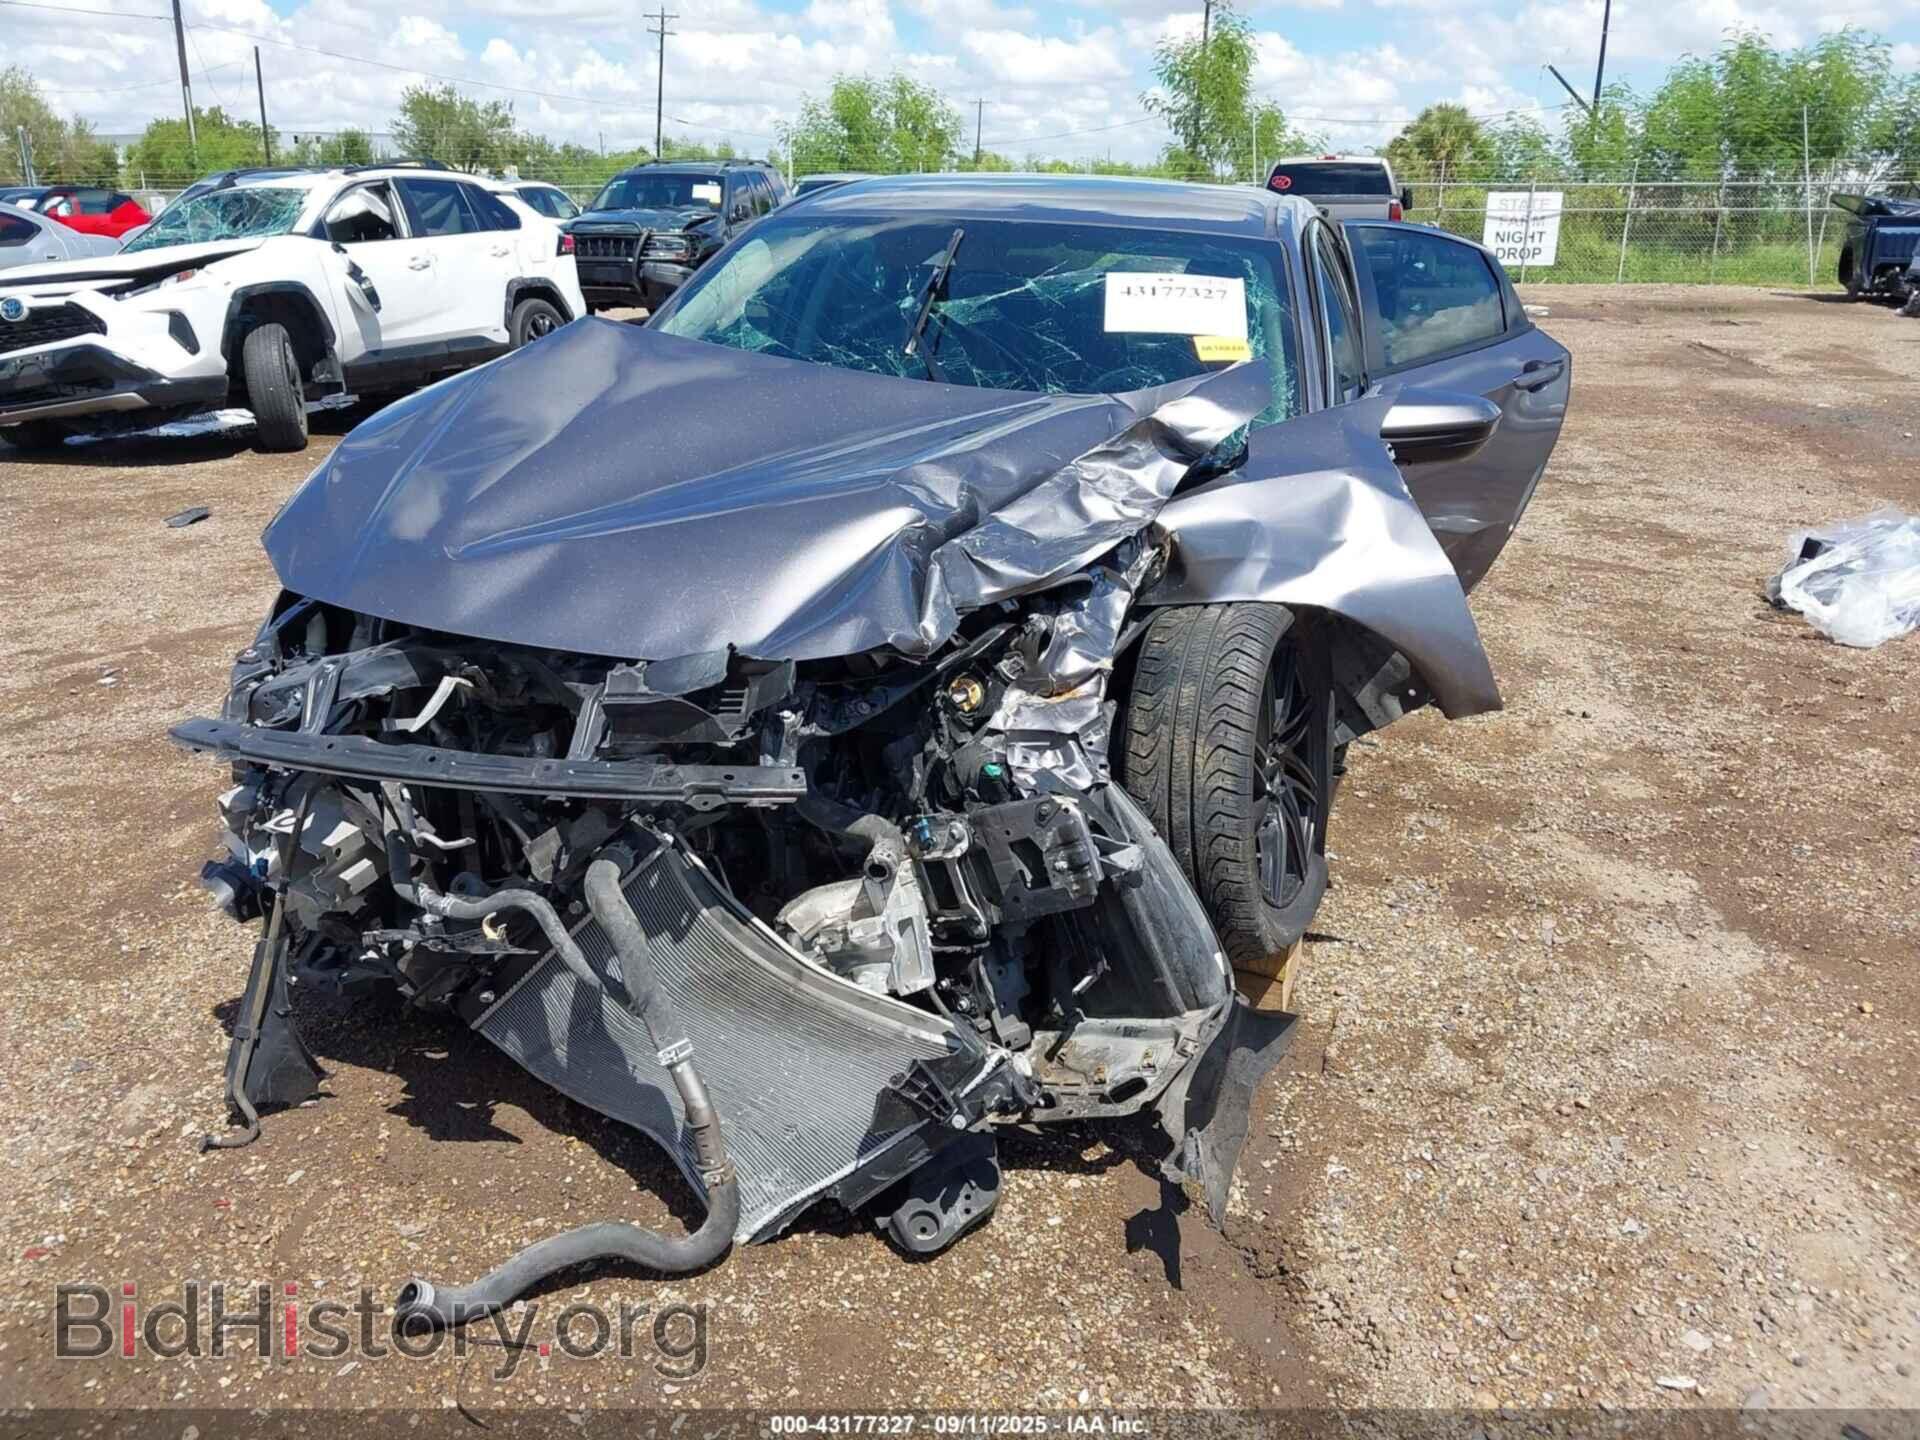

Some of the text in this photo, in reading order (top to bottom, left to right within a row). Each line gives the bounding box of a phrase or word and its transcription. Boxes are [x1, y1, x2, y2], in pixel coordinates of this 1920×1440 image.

[1495, 231, 1547, 244] NIGHT
[1495, 247, 1542, 260] DROP
[1120, 285, 1228, 301] 43177327
